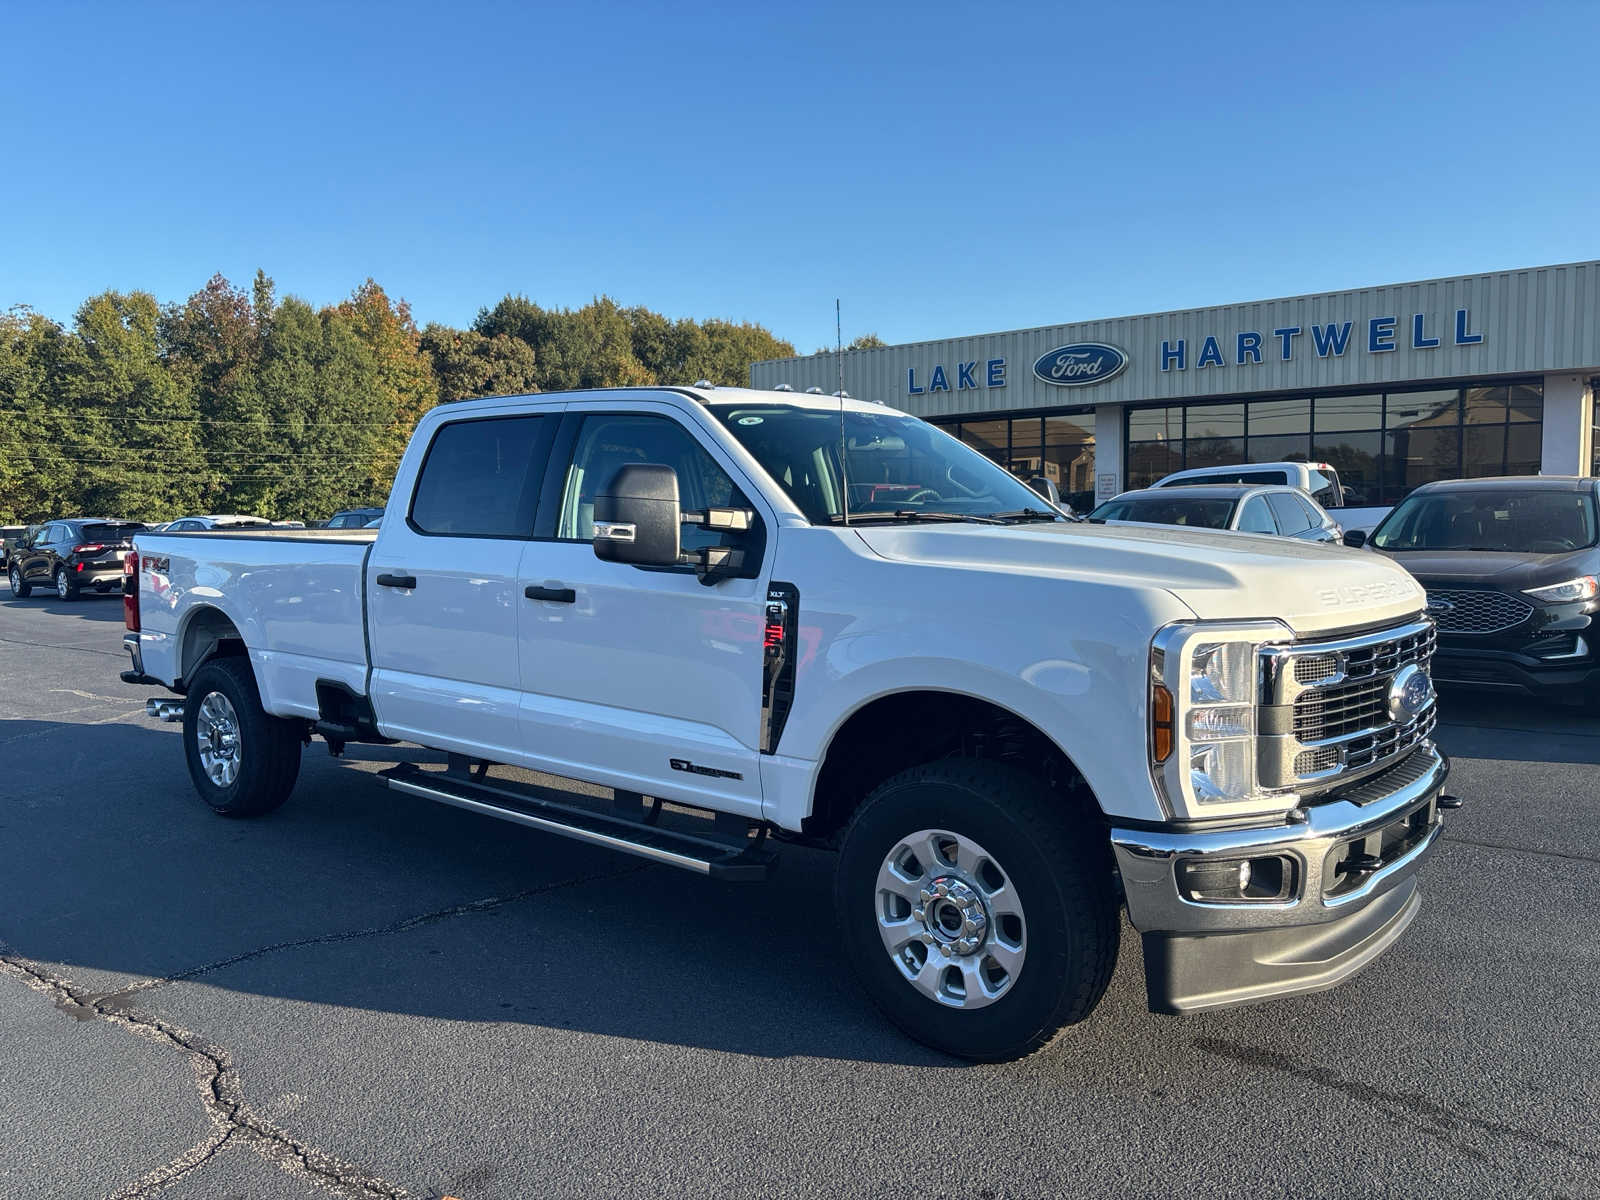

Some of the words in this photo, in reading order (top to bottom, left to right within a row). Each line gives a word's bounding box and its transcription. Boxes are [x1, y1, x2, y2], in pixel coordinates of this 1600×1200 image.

[907, 357, 1007, 395] LAKE
[1052, 353, 1103, 378] Ford
[1160, 308, 1484, 372] HARTWELL
[142, 555, 170, 572] FX4
[769, 590, 784, 598] XLT
